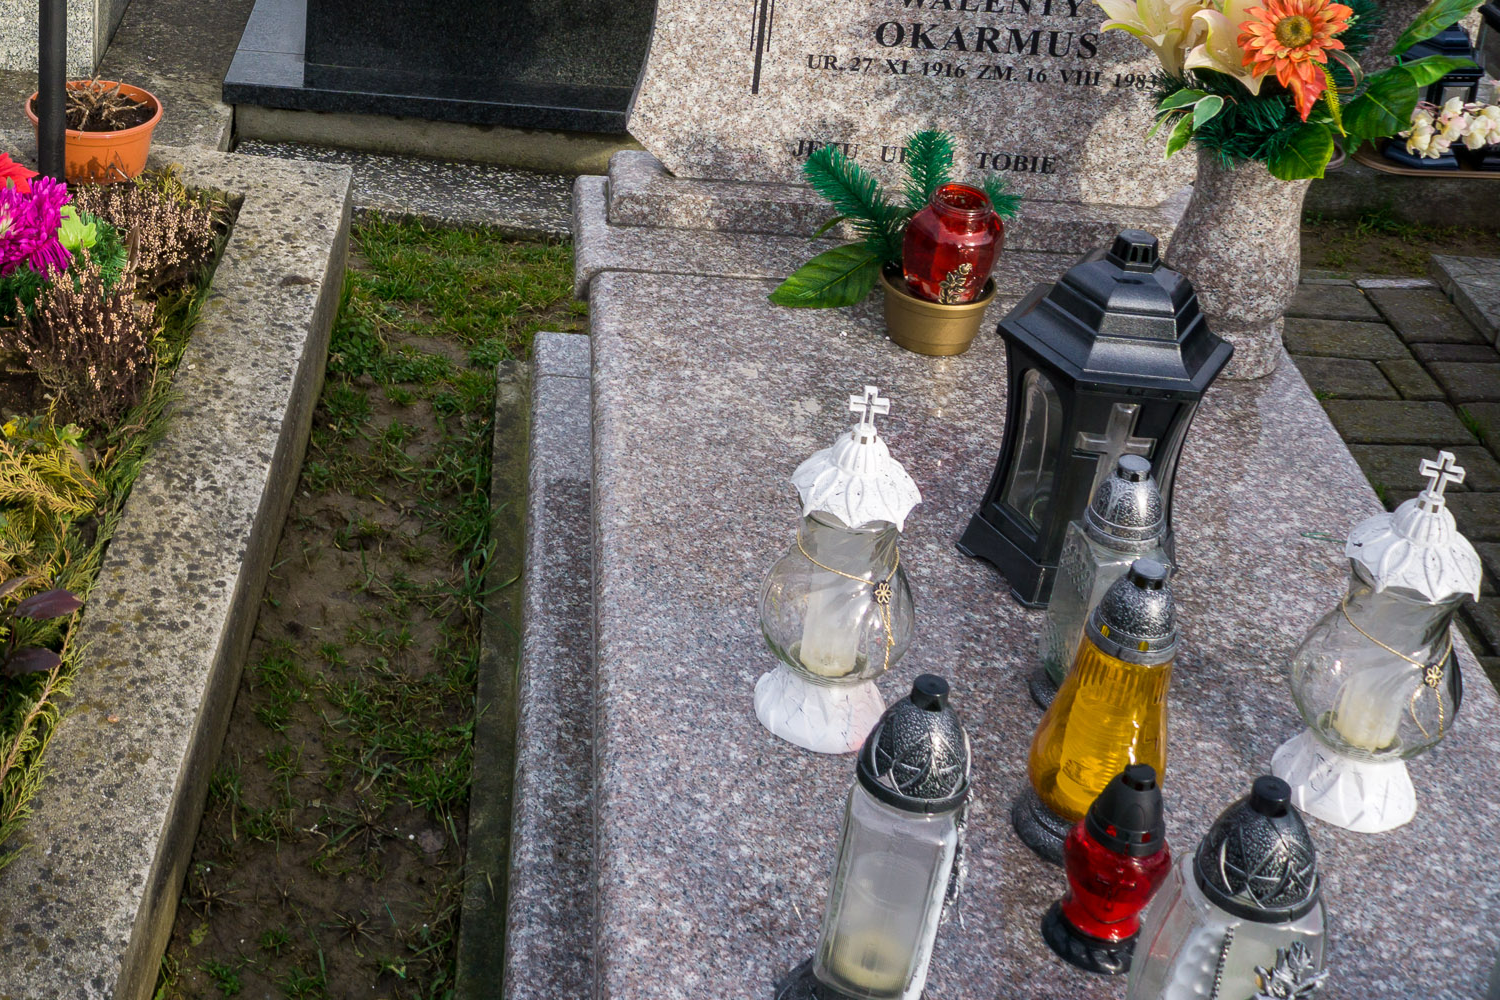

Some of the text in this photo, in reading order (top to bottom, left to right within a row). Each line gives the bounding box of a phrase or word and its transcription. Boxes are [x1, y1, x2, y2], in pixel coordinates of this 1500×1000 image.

[875, 20, 1100, 60] OKARMUS
[807, 53, 843, 72] UR.
[850, 56, 873, 73] 27
[884, 58, 910, 76] XI
[922, 60, 966, 79] 1916
[976, 63, 1018, 83] ZM.
[1026, 66, 1048, 84] 16
[1059, 67, 1101, 88] VIII
[976, 152, 1057, 175] TOBIE
